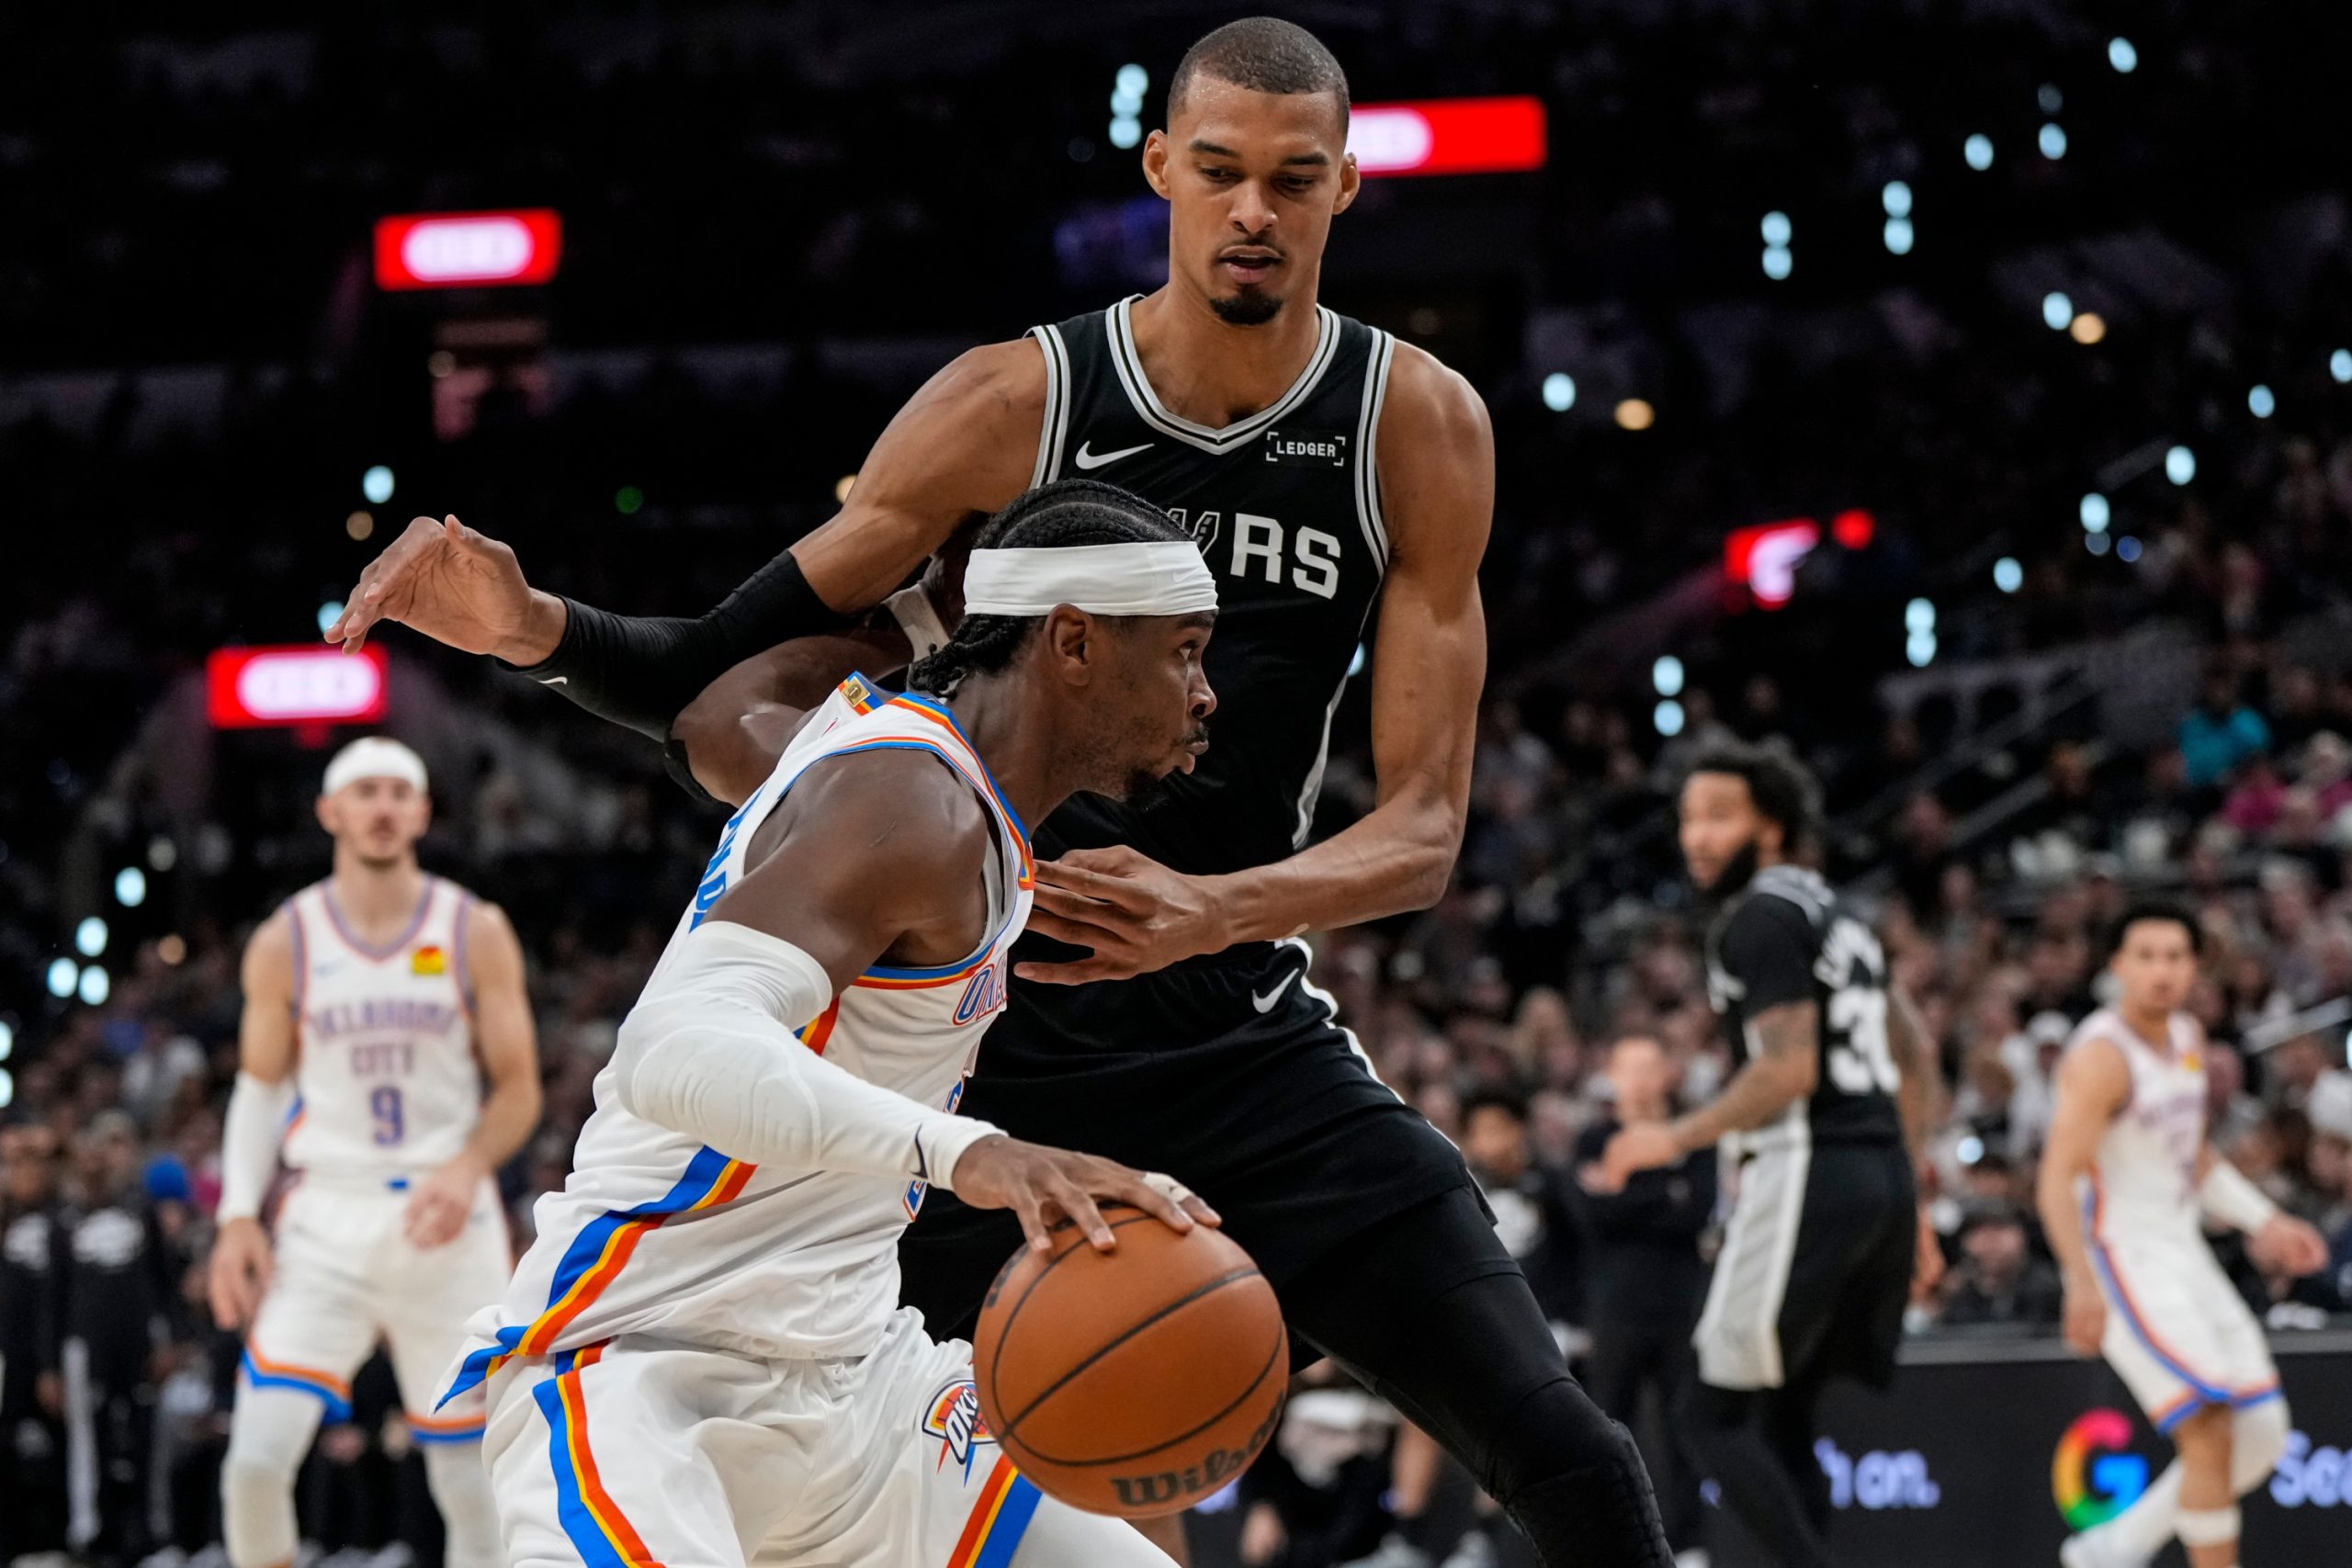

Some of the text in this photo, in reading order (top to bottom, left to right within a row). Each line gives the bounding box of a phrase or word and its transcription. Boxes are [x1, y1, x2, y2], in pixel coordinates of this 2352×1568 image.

[1276, 441, 1337, 457] LEDGER
[371, 1086, 404, 1147] 9
[944, 1387, 978, 1461] OKC
[2269, 1429, 2352, 1508] Se
